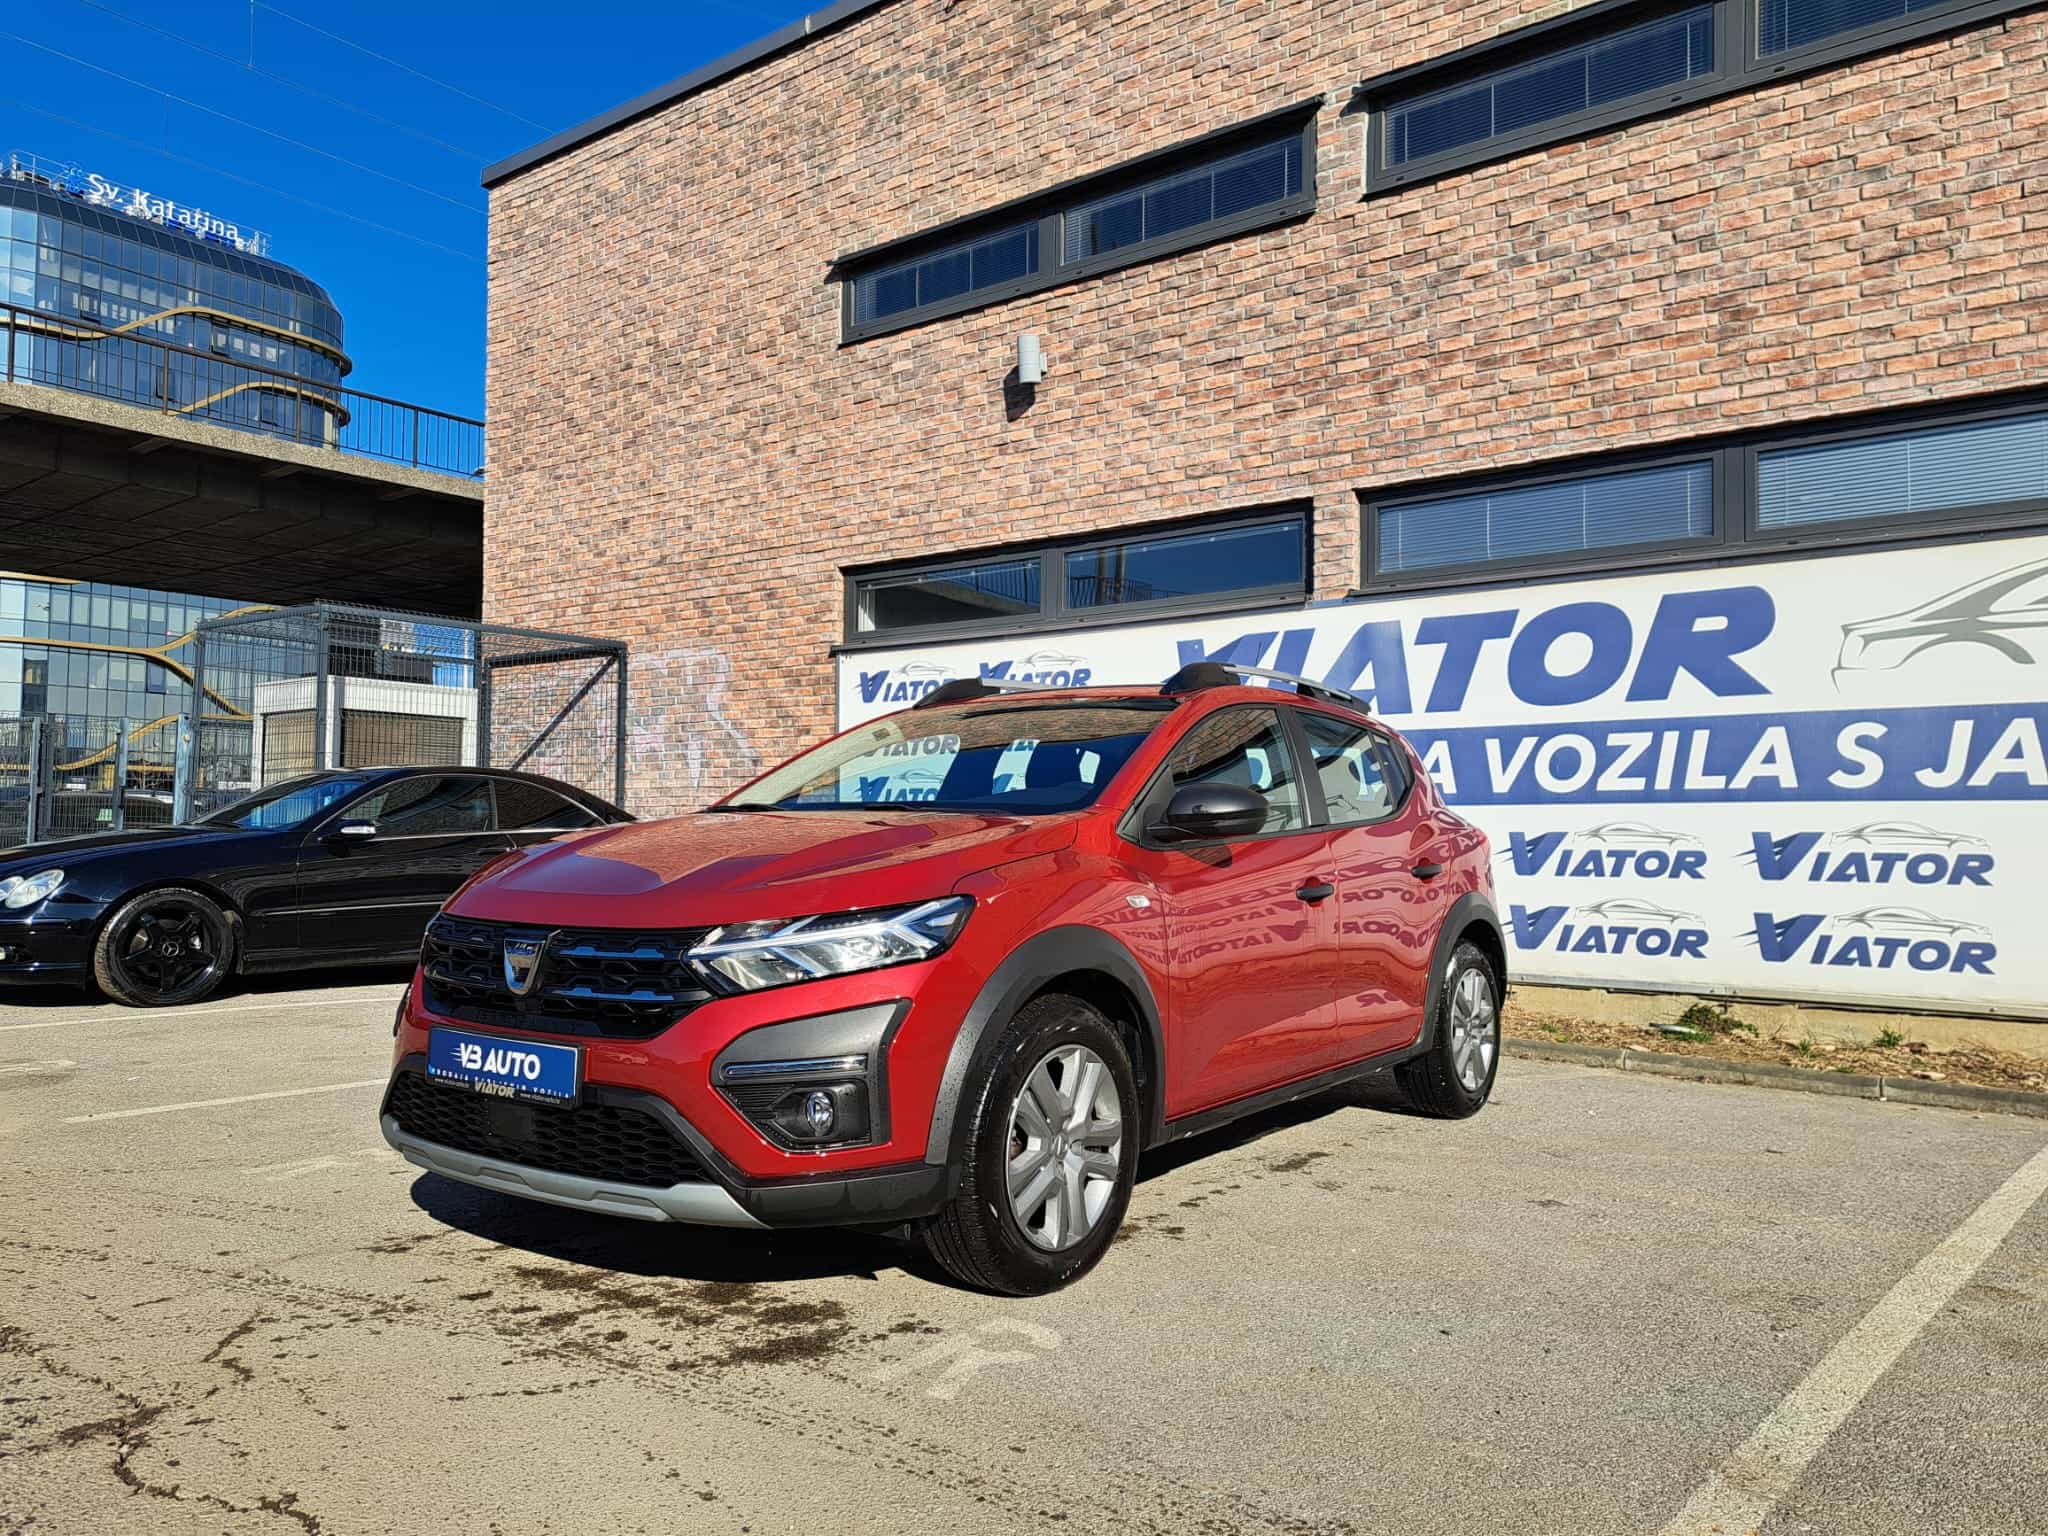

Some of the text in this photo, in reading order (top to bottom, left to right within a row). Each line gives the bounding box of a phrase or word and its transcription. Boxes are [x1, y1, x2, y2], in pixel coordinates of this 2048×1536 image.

[1484, 725, 1799, 793] VOZILA
[1826, 721, 1889, 789] S
[1914, 717, 2048, 789] JA
[1507, 831, 1708, 880] VIATOR
[1751, 831, 1995, 887] VIATOR
[1508, 904, 1710, 959] VIATOR
[1752, 911, 1998, 975] VIATOR
[459, 1041, 541, 1080] VB AUTO
[474, 1079, 515, 1099] VIATOR
